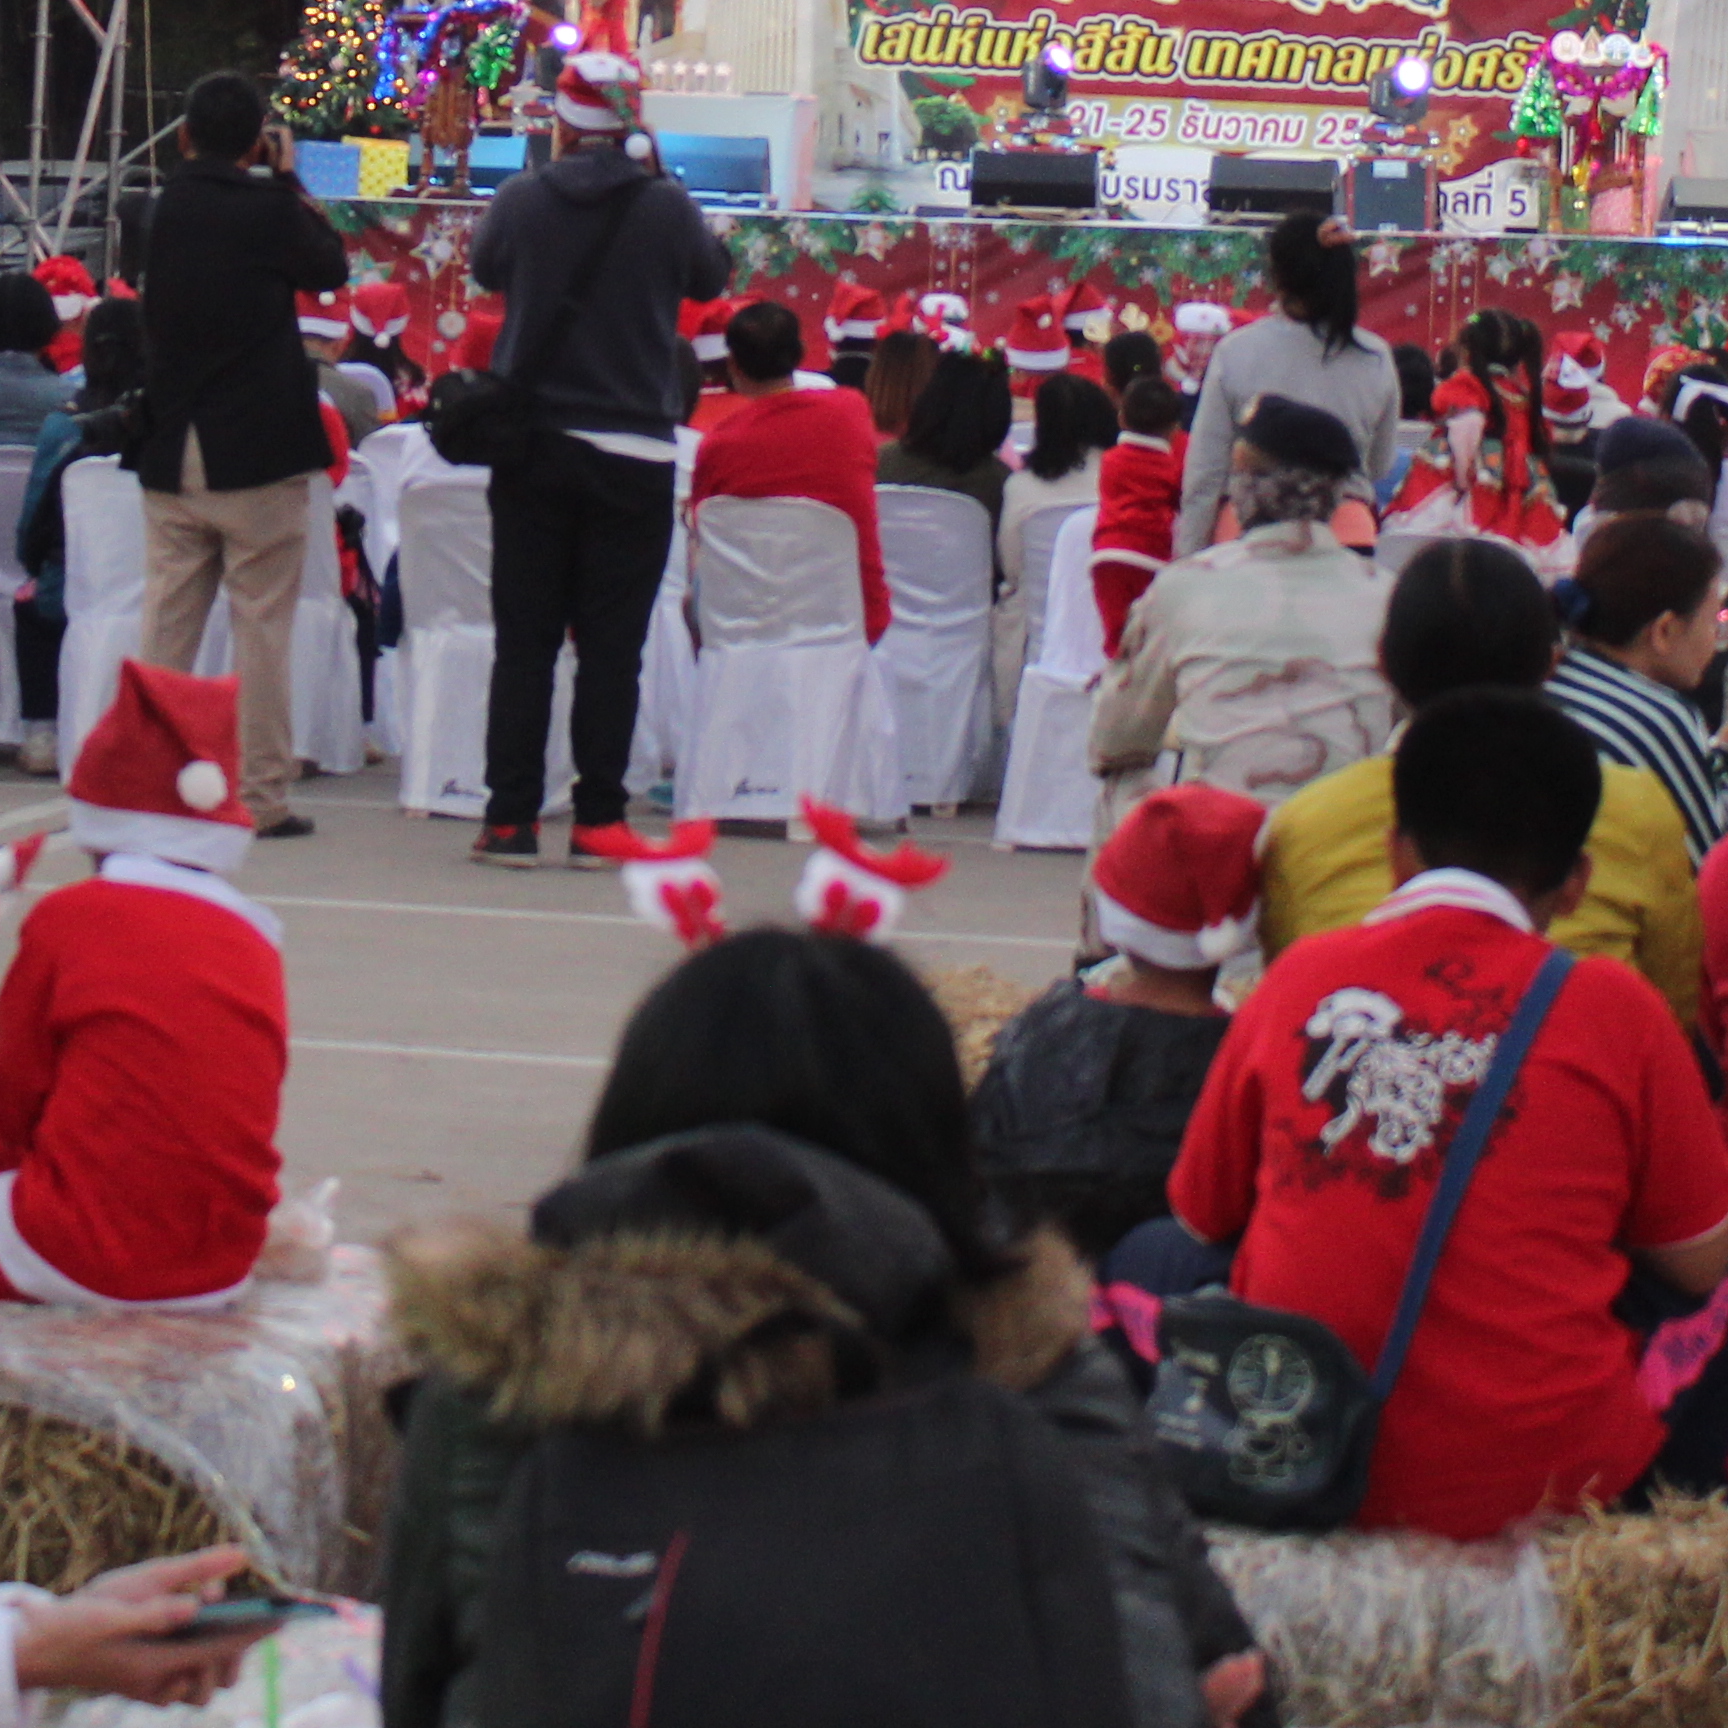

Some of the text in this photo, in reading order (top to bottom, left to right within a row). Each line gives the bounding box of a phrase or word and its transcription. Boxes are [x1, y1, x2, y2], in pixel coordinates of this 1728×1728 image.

[1180, 103, 1306, 144] ธันวาคม
[1508, 188, 1527, 217] 5
